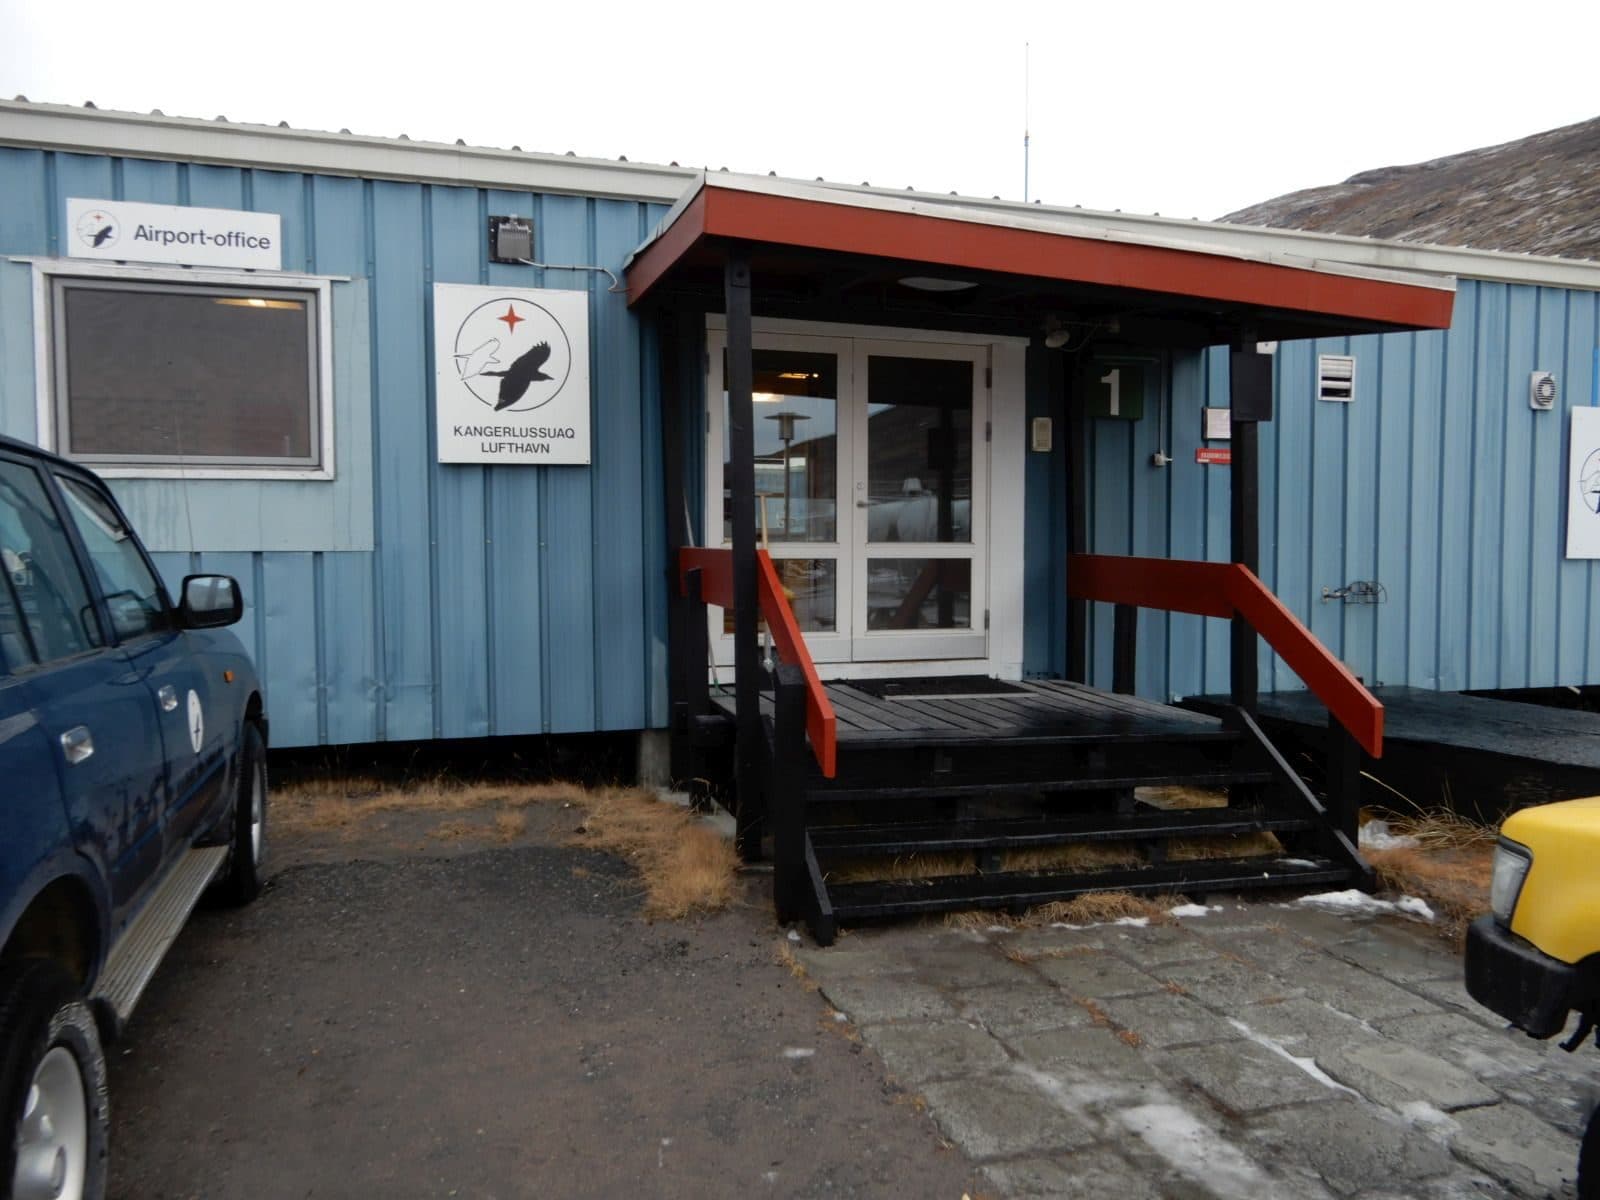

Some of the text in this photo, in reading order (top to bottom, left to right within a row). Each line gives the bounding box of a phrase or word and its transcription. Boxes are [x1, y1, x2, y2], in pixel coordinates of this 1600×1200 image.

[134, 224, 271, 250] Airport-office
[1100, 369, 1120, 416] 1
[453, 425, 575, 440] KANGERLUSSUAQ
[481, 442, 550, 454] LUFTHAVN
